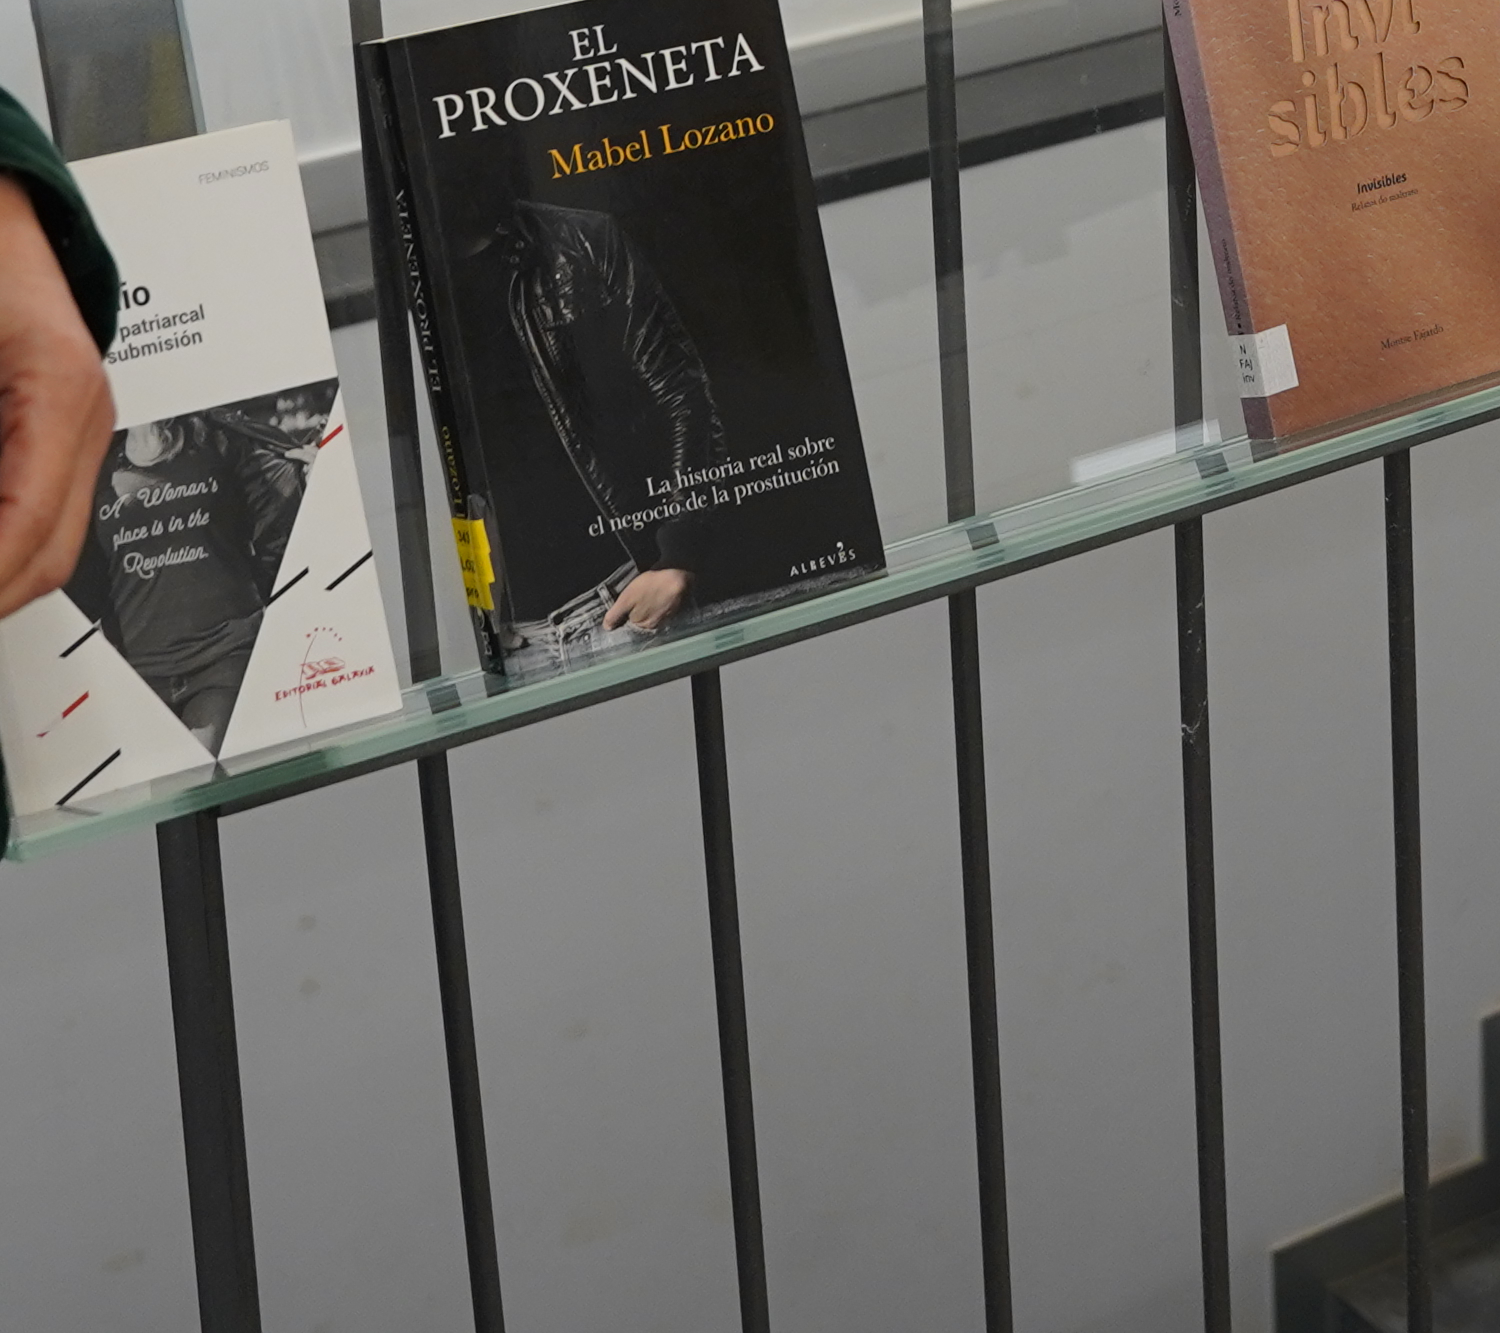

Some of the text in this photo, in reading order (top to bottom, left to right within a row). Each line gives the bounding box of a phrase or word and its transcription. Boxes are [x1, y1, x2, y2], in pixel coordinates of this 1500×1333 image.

[568, 25, 618, 61] EL
[432, 32, 765, 139] PROXENETA
[1268, 52, 1469, 158] sibles
[547, 112, 775, 179] Mabel Lozano
[198, 160, 269, 185] FEMINISMOS
[1357, 173, 1407, 195] Invisibles
[1378, 195, 1387, 205] do
[396, 189, 442, 393] EL PROXENETA
[119, 303, 205, 343] patriarcal
[1381, 323, 1444, 350] Montse Fajardo
[106, 329, 203, 365] submisión
[1239, 345, 1247, 355] N
[1239, 359, 1253, 371] FAJ
[1242, 373, 1255, 383] inv
[442, 426, 463, 504] Lozano
[646, 435, 836, 498] La historia real sobre
[100, 476, 219, 520] A Woman's
[588, 458, 841, 537] el negocio de la prostitución
[113, 508, 210, 551] place is in the
[124, 545, 210, 580] Revolution.
[274, 665, 376, 702] EDITORIAL GALAXIA
